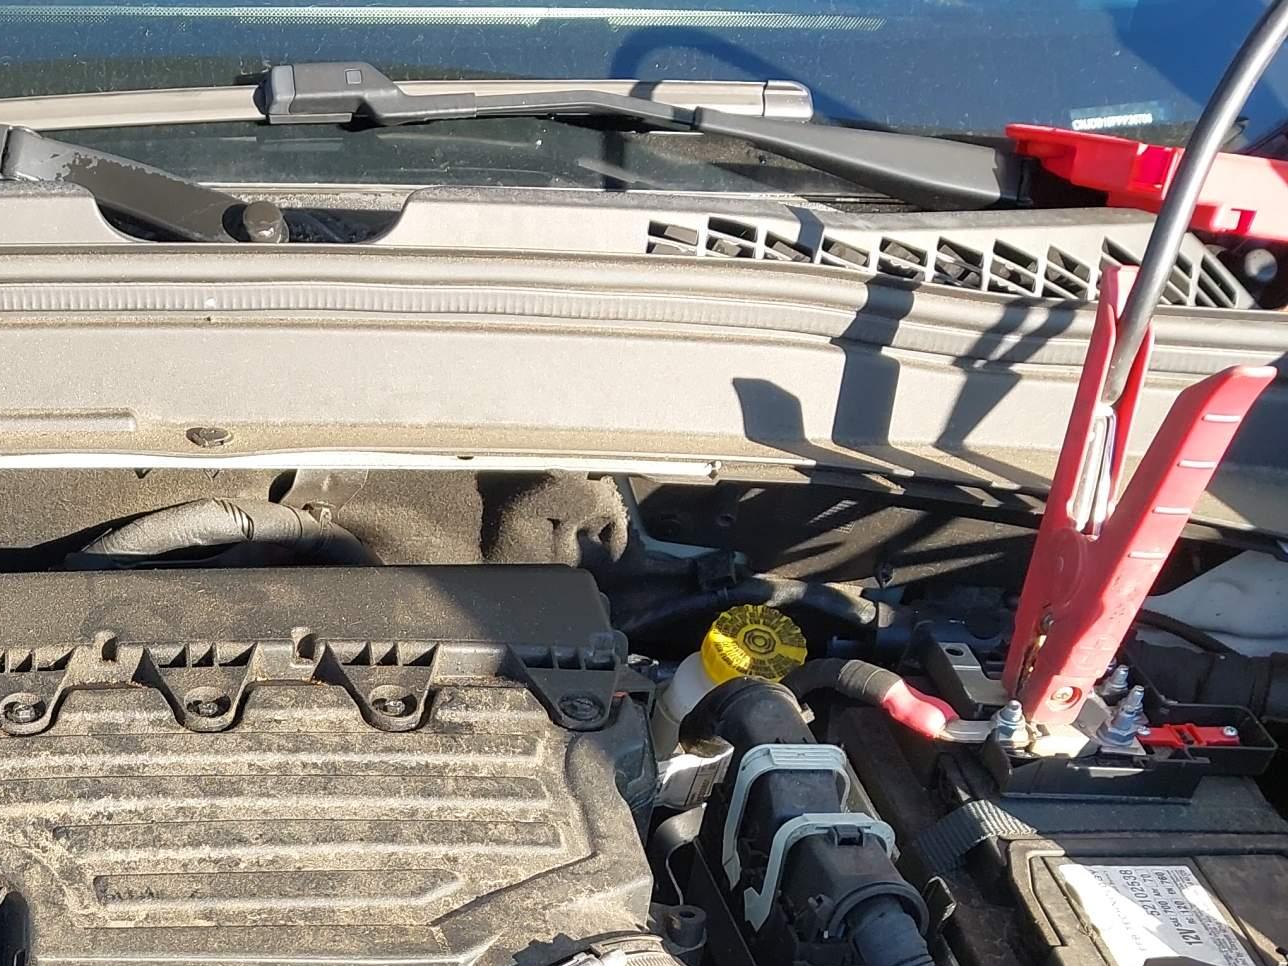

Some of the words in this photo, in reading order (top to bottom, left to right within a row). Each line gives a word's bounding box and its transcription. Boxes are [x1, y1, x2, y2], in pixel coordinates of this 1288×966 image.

[1140, 873, 1153, 882] 70
[1155, 871, 1171, 884] 760
[1119, 869, 1161, 916] 52102538
[1088, 869, 1133, 932] TECHNOGY
[1158, 900, 1173, 913] 700
[1174, 900, 1189, 912] 120
[1176, 928, 1203, 945] 12V
